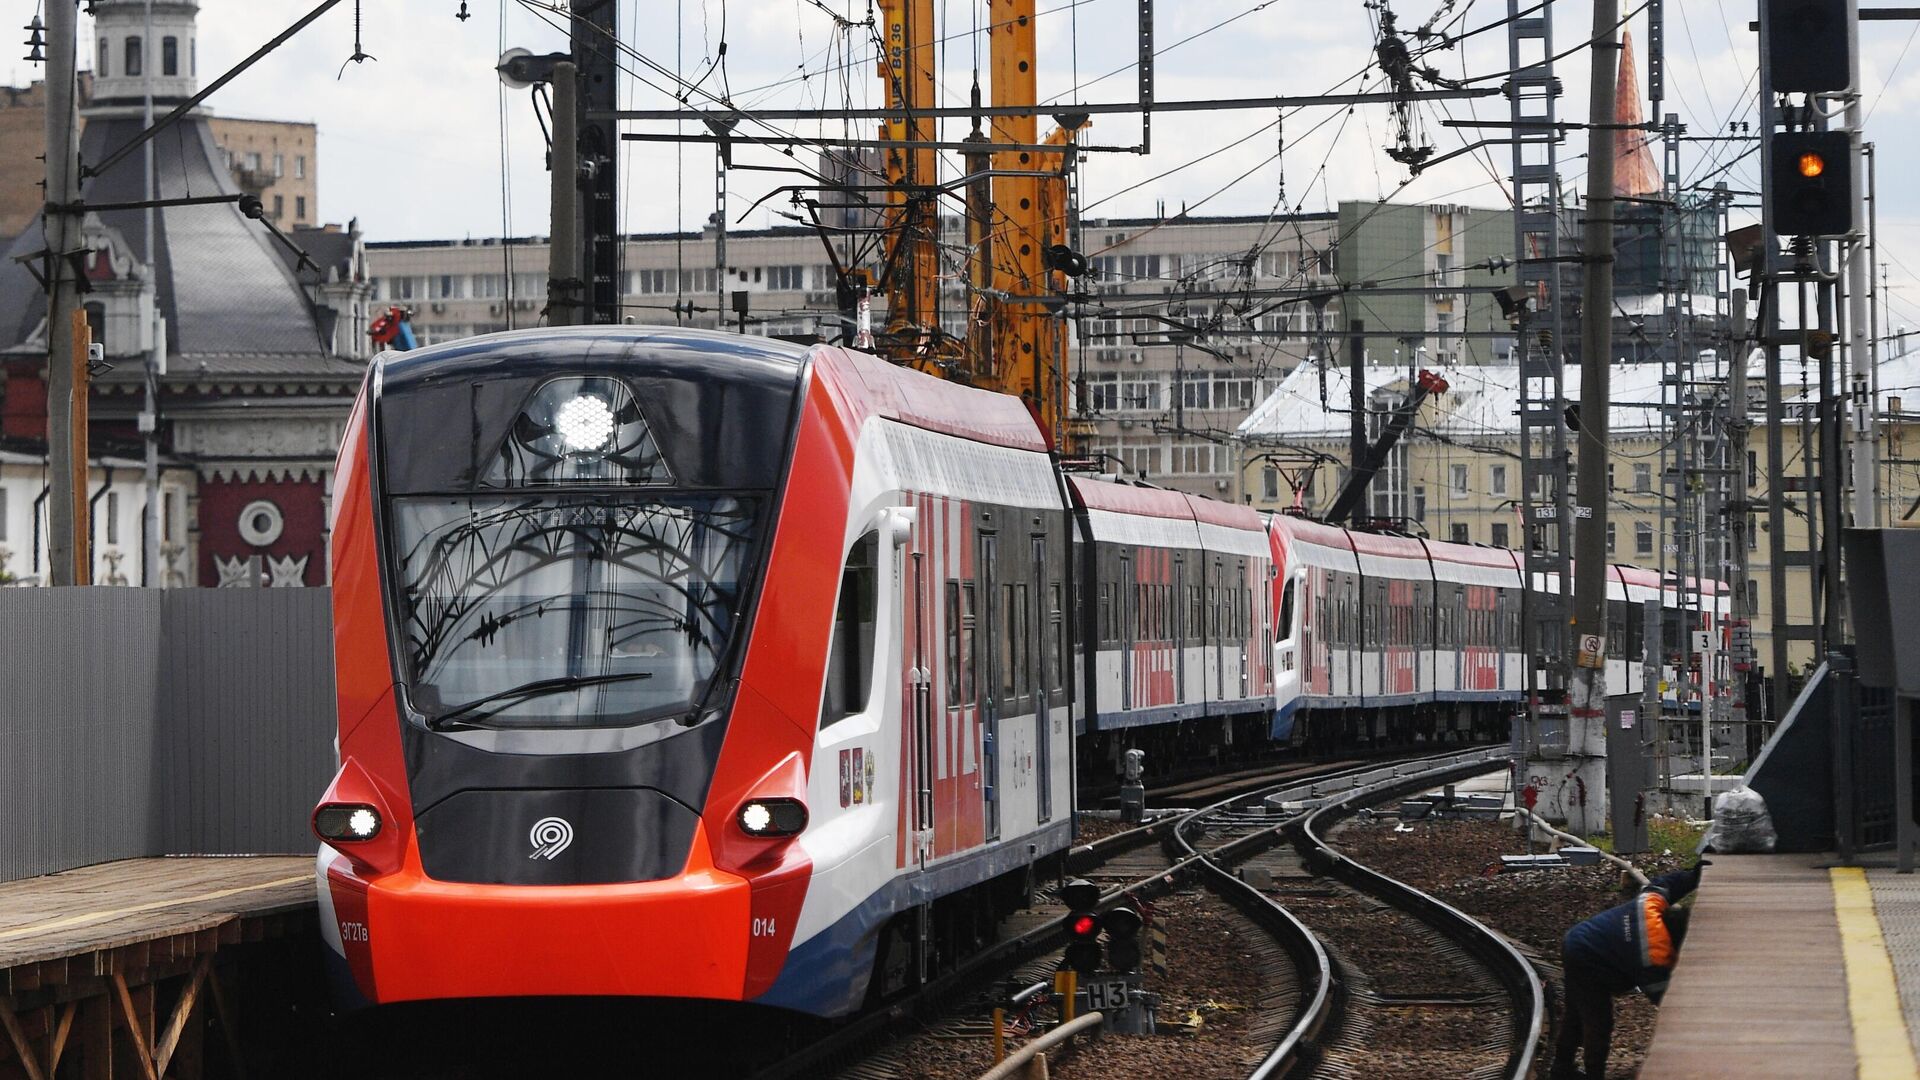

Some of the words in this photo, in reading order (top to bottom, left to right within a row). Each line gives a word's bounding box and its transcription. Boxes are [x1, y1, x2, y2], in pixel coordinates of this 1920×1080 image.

[892, 23, 902, 42] 36
[893, 46, 902, 69] BG
[1536, 508, 1556, 518] 131
[1701, 634, 1709, 649] 3
[753, 918, 776, 937] 014
